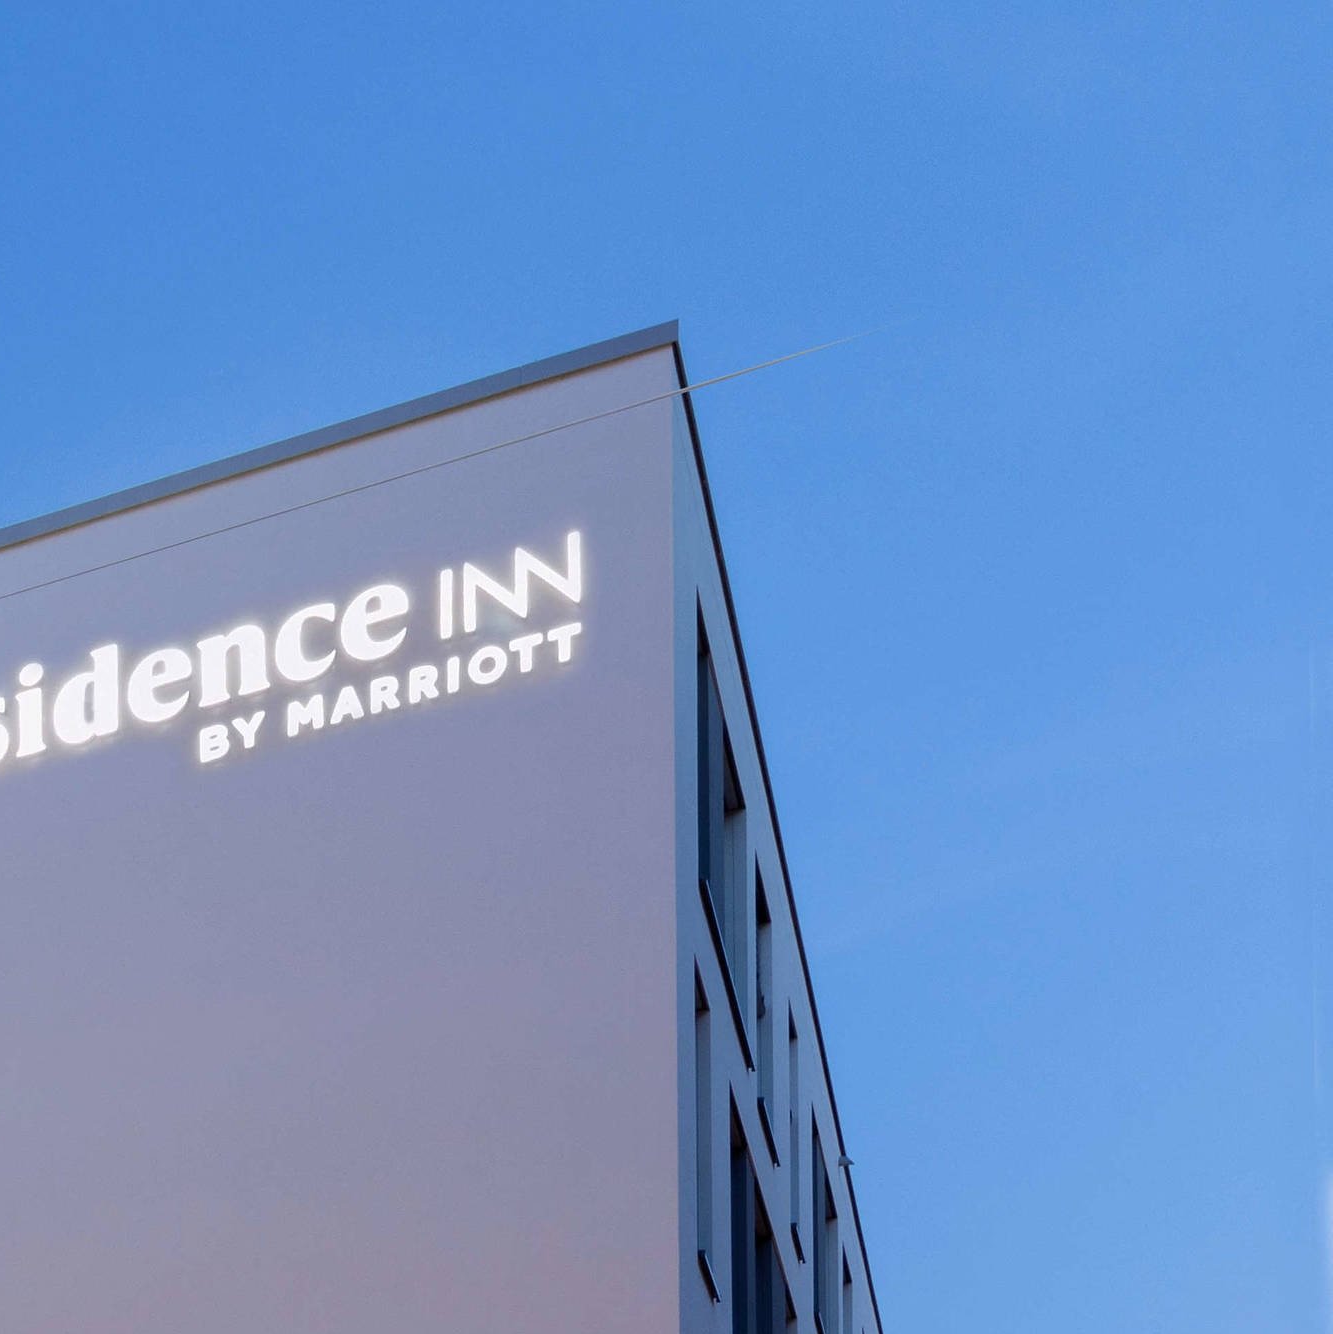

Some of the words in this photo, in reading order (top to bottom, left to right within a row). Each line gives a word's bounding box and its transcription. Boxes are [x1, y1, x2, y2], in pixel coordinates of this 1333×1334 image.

[439, 531, 582, 640] INN
[199, 710, 266, 763] BY
[286, 622, 582, 737] MARRIOTT
